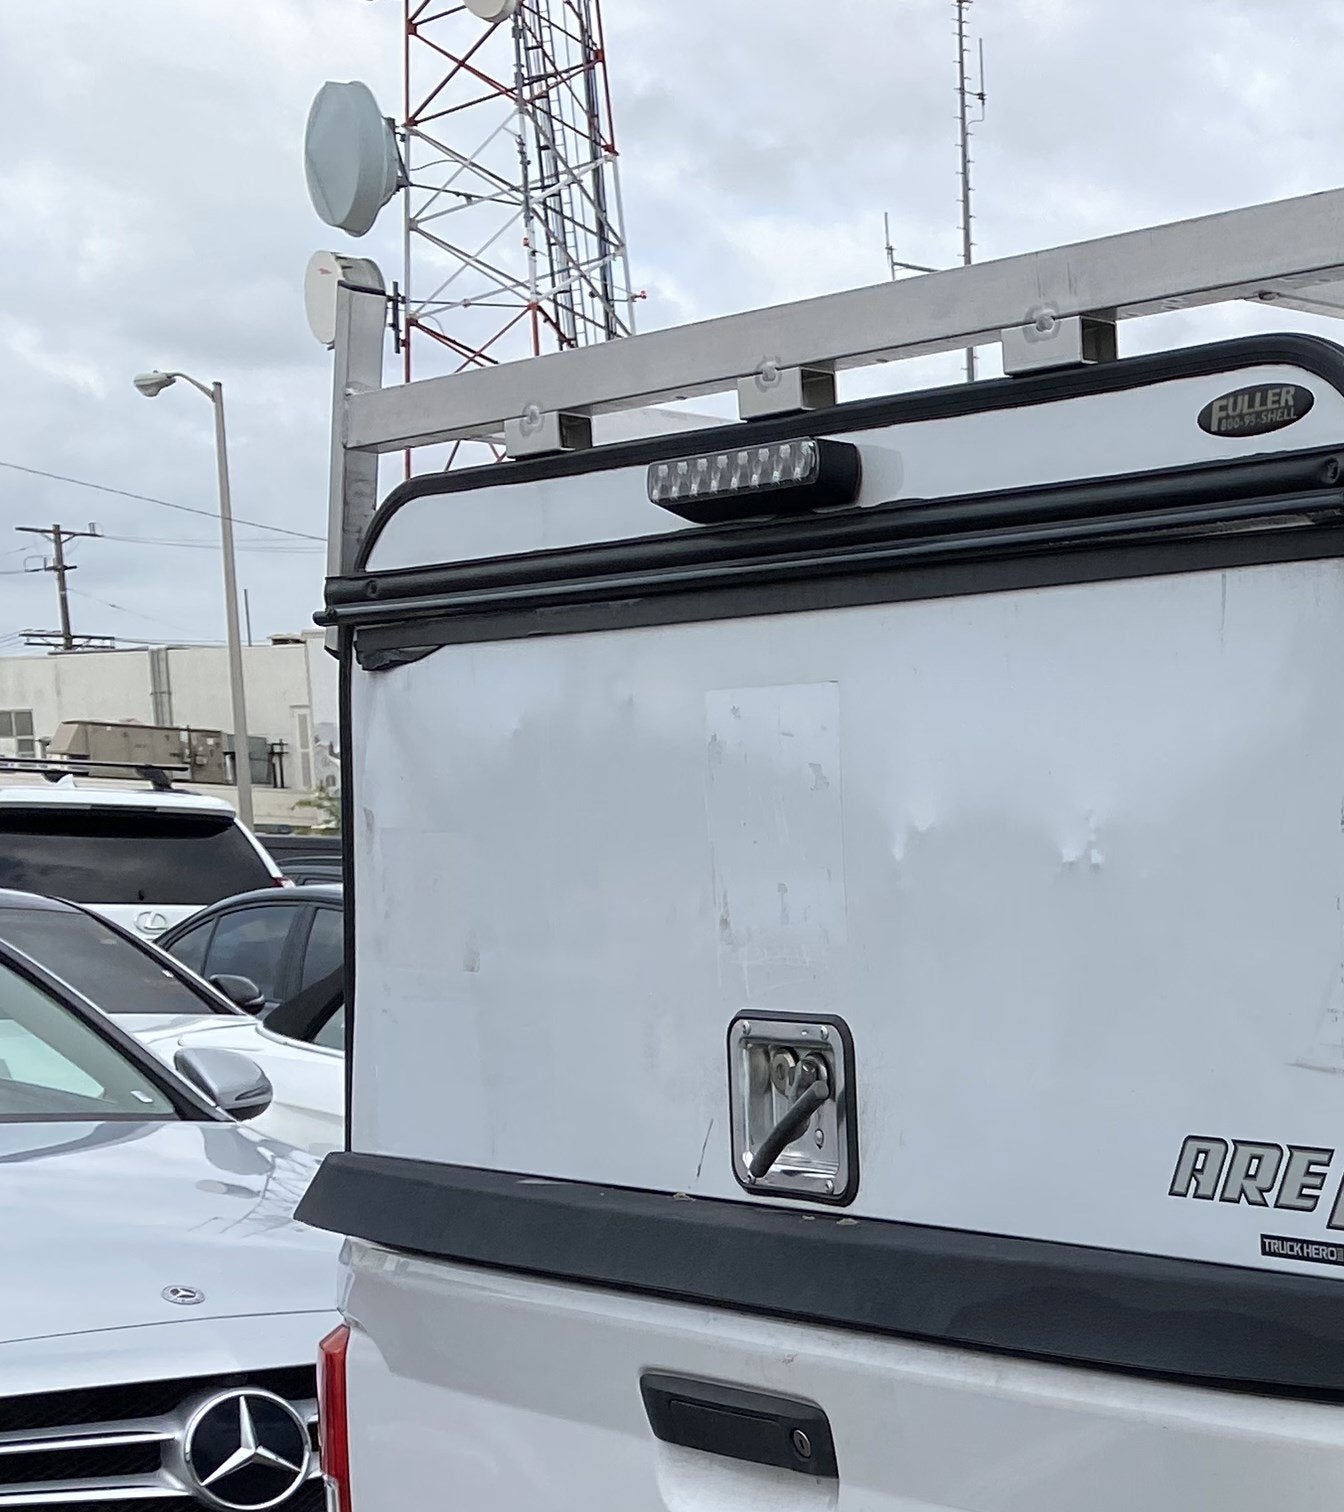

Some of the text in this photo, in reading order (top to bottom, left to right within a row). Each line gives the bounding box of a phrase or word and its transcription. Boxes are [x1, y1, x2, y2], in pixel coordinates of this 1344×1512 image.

[1210, 386, 1296, 432] FULLER
[1263, 1238, 1337, 1261] TRUCK HERO
